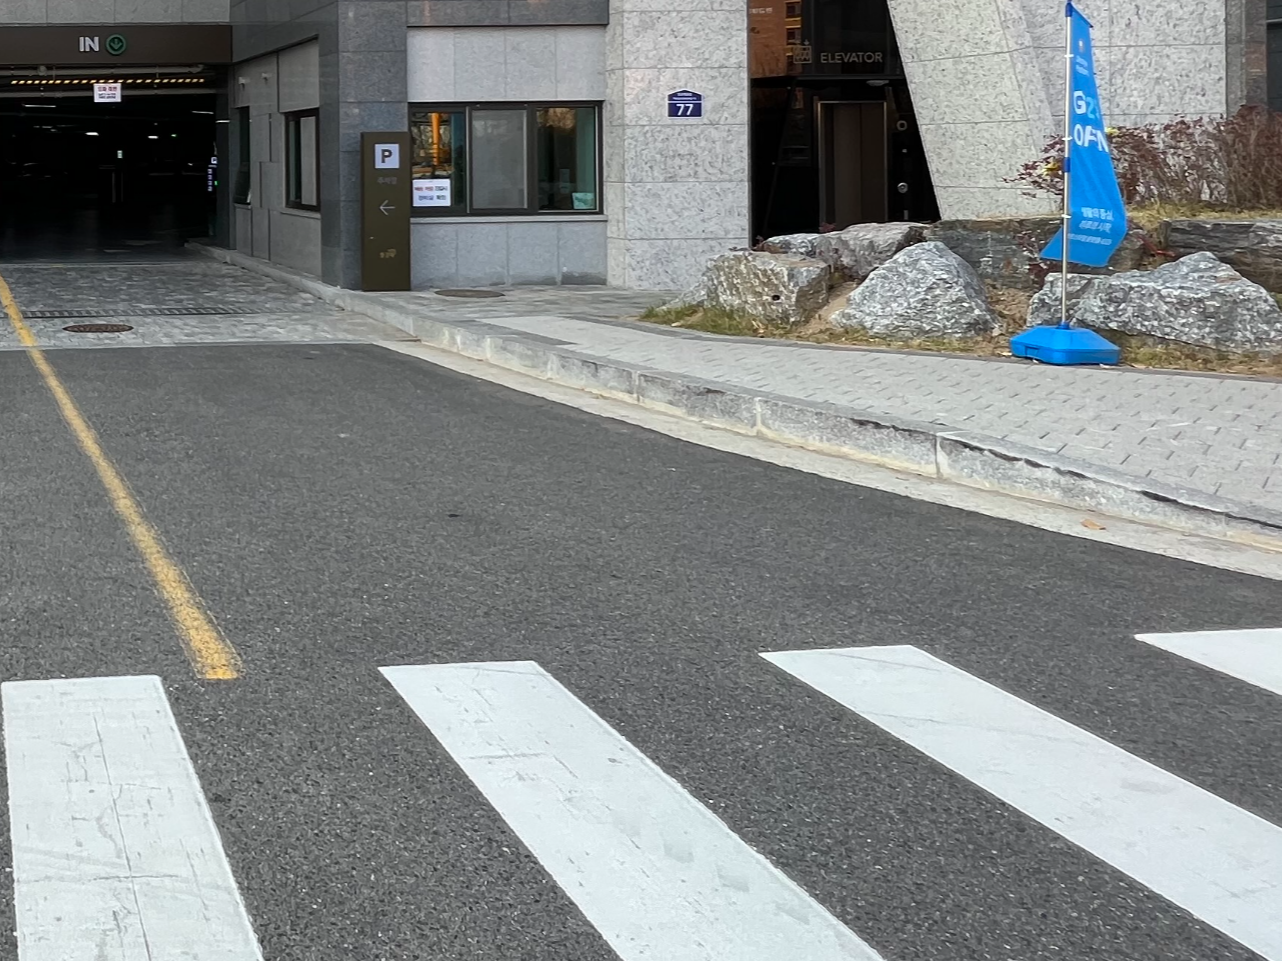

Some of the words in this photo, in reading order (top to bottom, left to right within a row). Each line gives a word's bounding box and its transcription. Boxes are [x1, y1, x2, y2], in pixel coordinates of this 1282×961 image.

[79, 36, 100, 52] IN
[820, 52, 883, 64] ELEVATOR
[675, 103, 694, 116] 77
[381, 148, 393, 164] P
